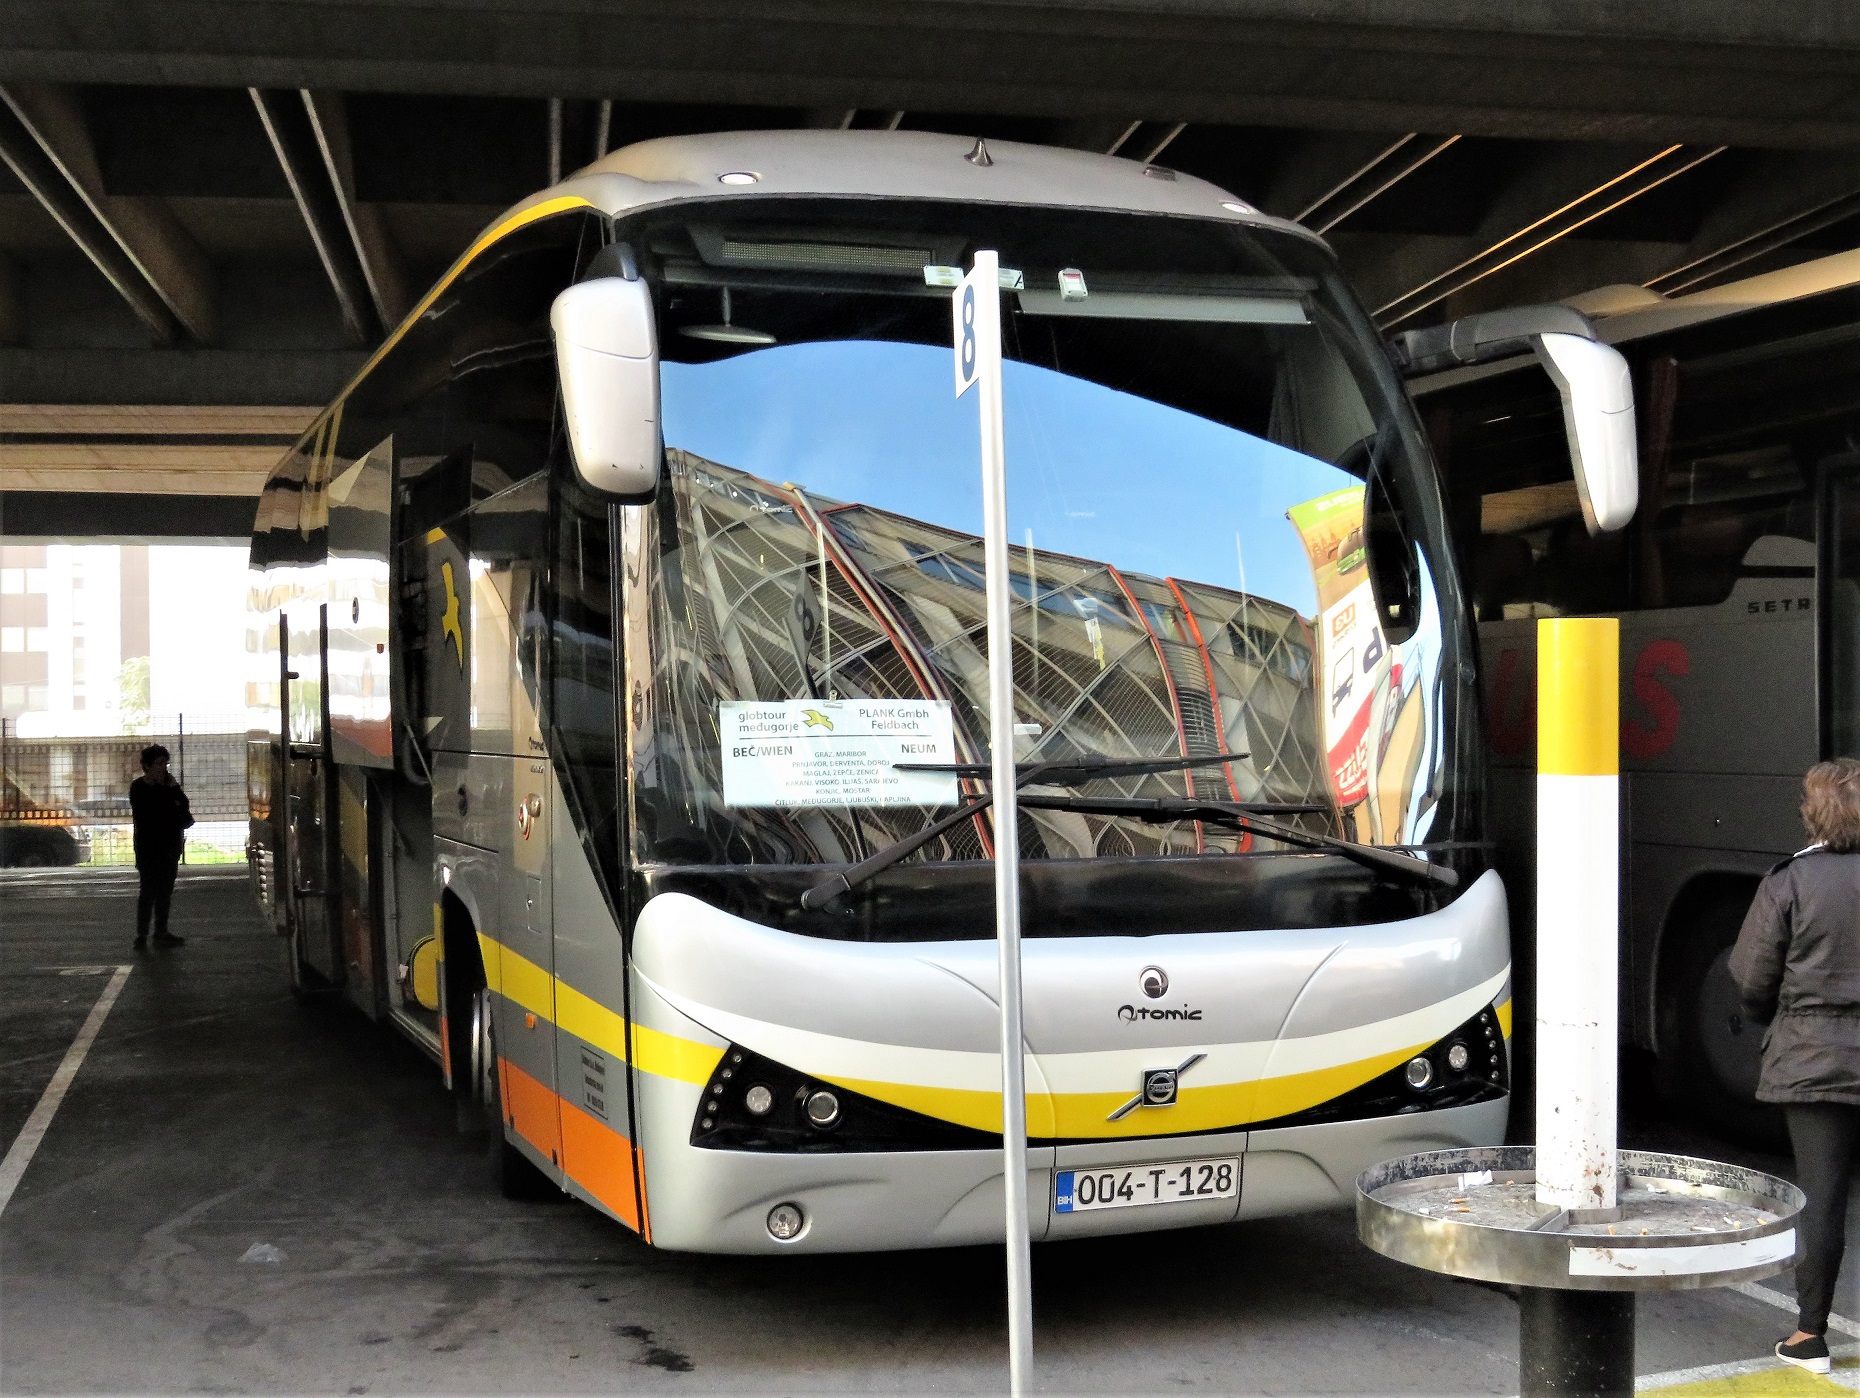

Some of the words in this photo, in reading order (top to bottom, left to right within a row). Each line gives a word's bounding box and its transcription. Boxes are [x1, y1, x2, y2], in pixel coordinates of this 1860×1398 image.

[961, 283, 977, 383] 8
[738, 711, 787, 722] globtour
[859, 708, 895, 718] PLANK
[897, 708, 930, 718] Gmbh
[871, 719, 919, 730] Feldbach
[732, 744, 793, 758] BEČ/WIEN
[901, 743, 937, 754] NEUM
[836, 750, 867, 758] MARIBOR
[1056, 1195, 1073, 1206] BIH
